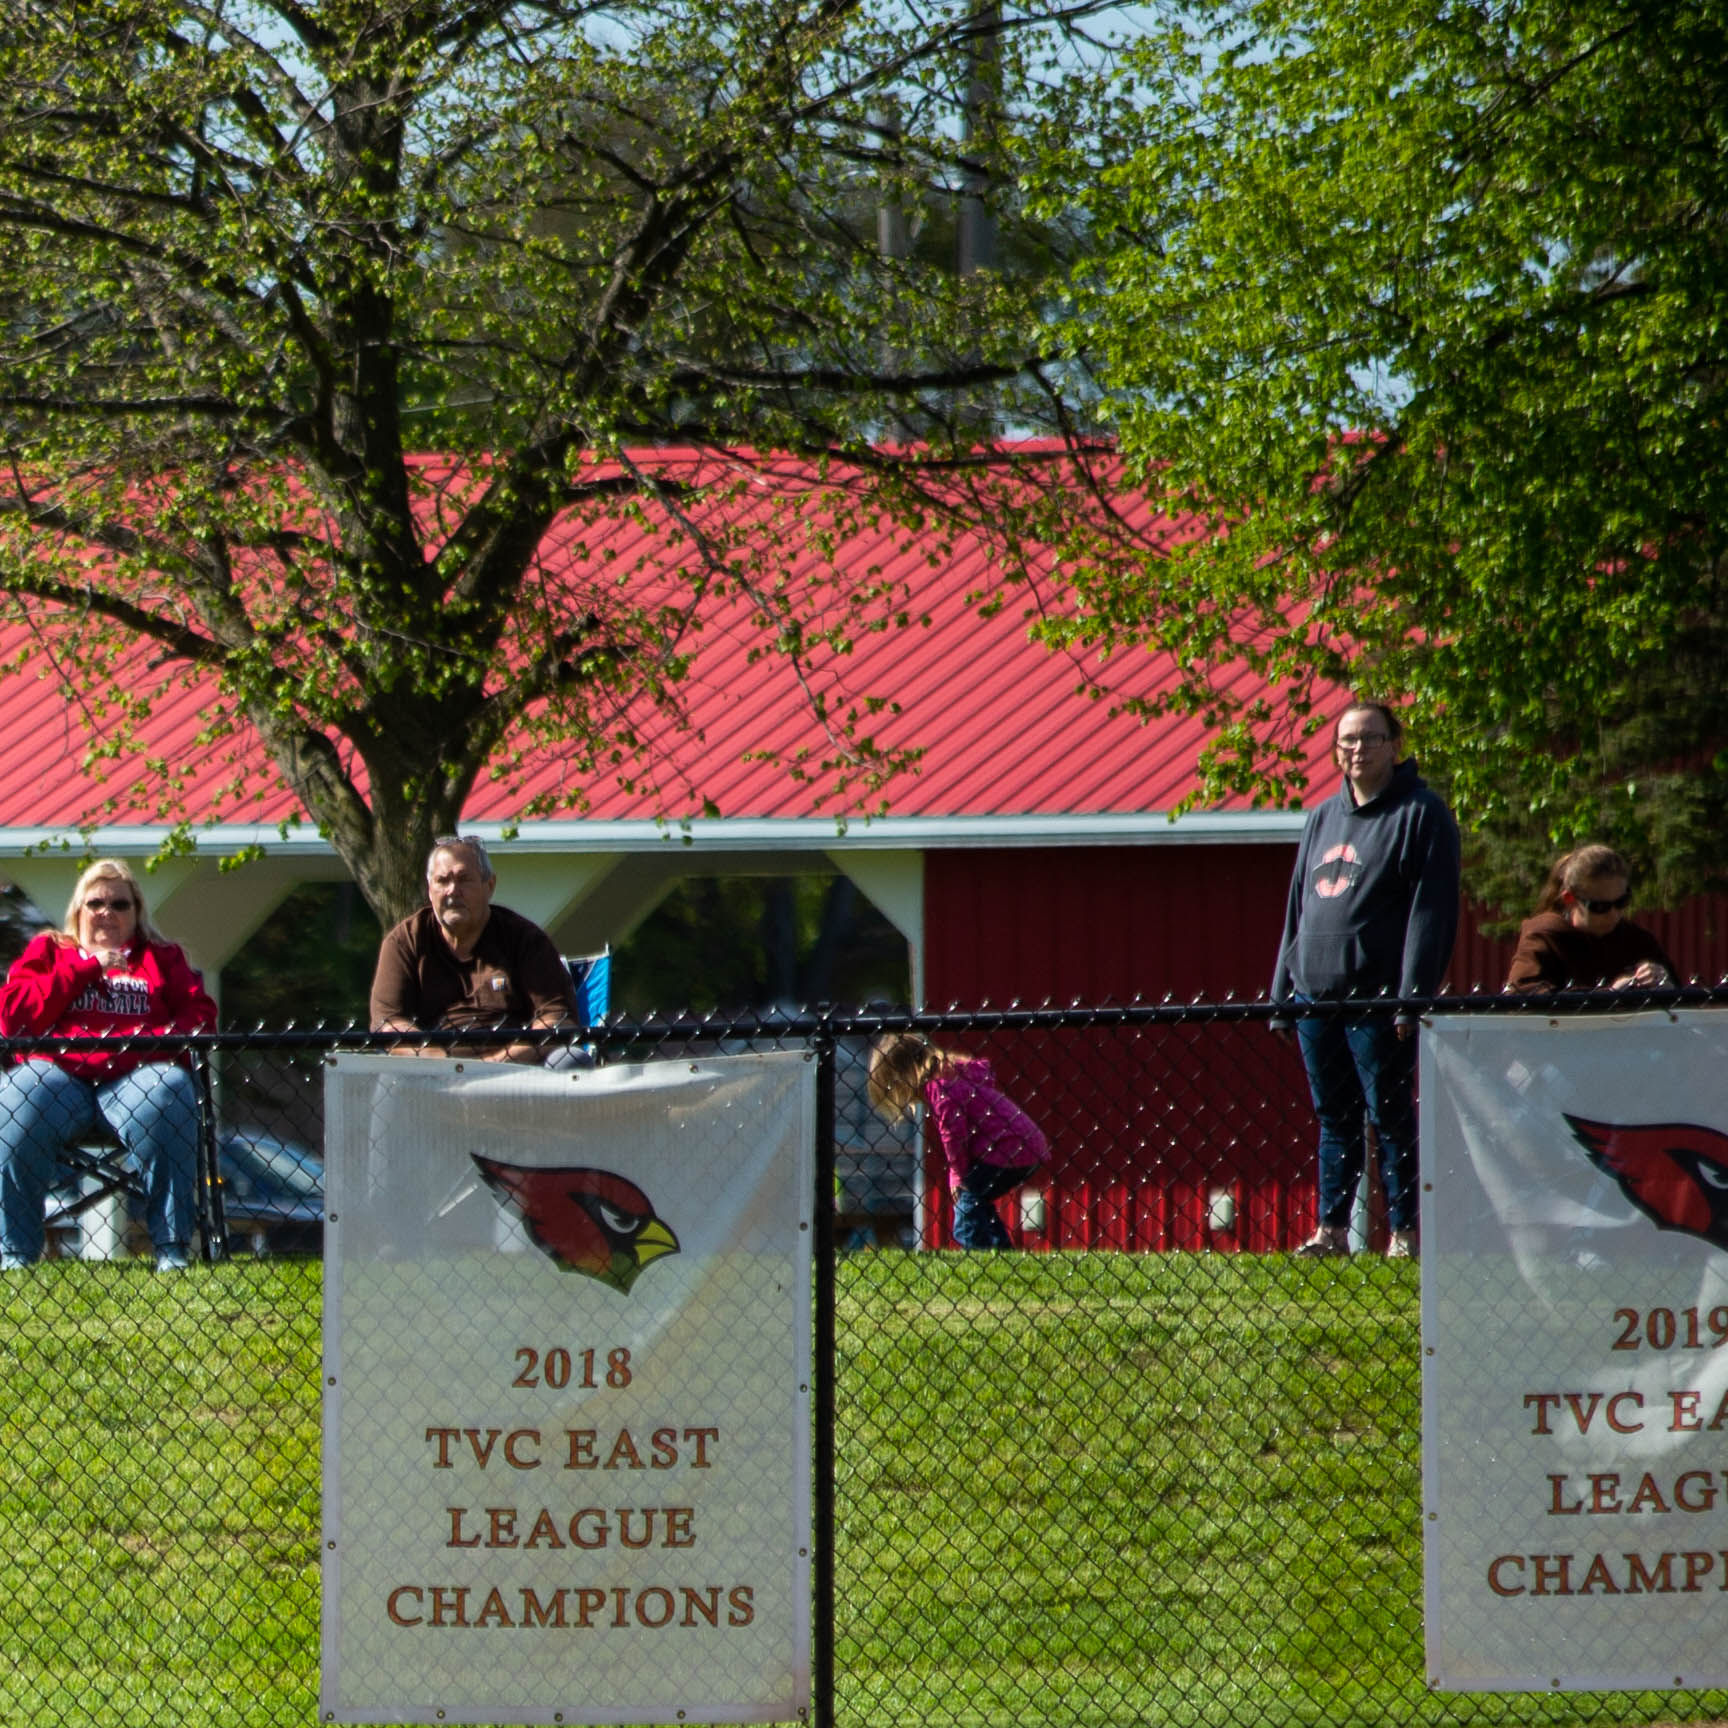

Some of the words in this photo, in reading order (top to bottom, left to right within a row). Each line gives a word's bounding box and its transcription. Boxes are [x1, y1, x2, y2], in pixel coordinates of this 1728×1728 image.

[1611, 1305, 1728, 1351] 2019
[512, 1347, 633, 1389] 2018
[1523, 1392, 1645, 1435] TVC
[425, 1428, 542, 1469] TVC
[563, 1427, 720, 1470] EAST
[1546, 1469, 1728, 1515] LEAG
[445, 1508, 697, 1549] LEAGUE
[386, 1586, 756, 1628] CHAMPIONS
